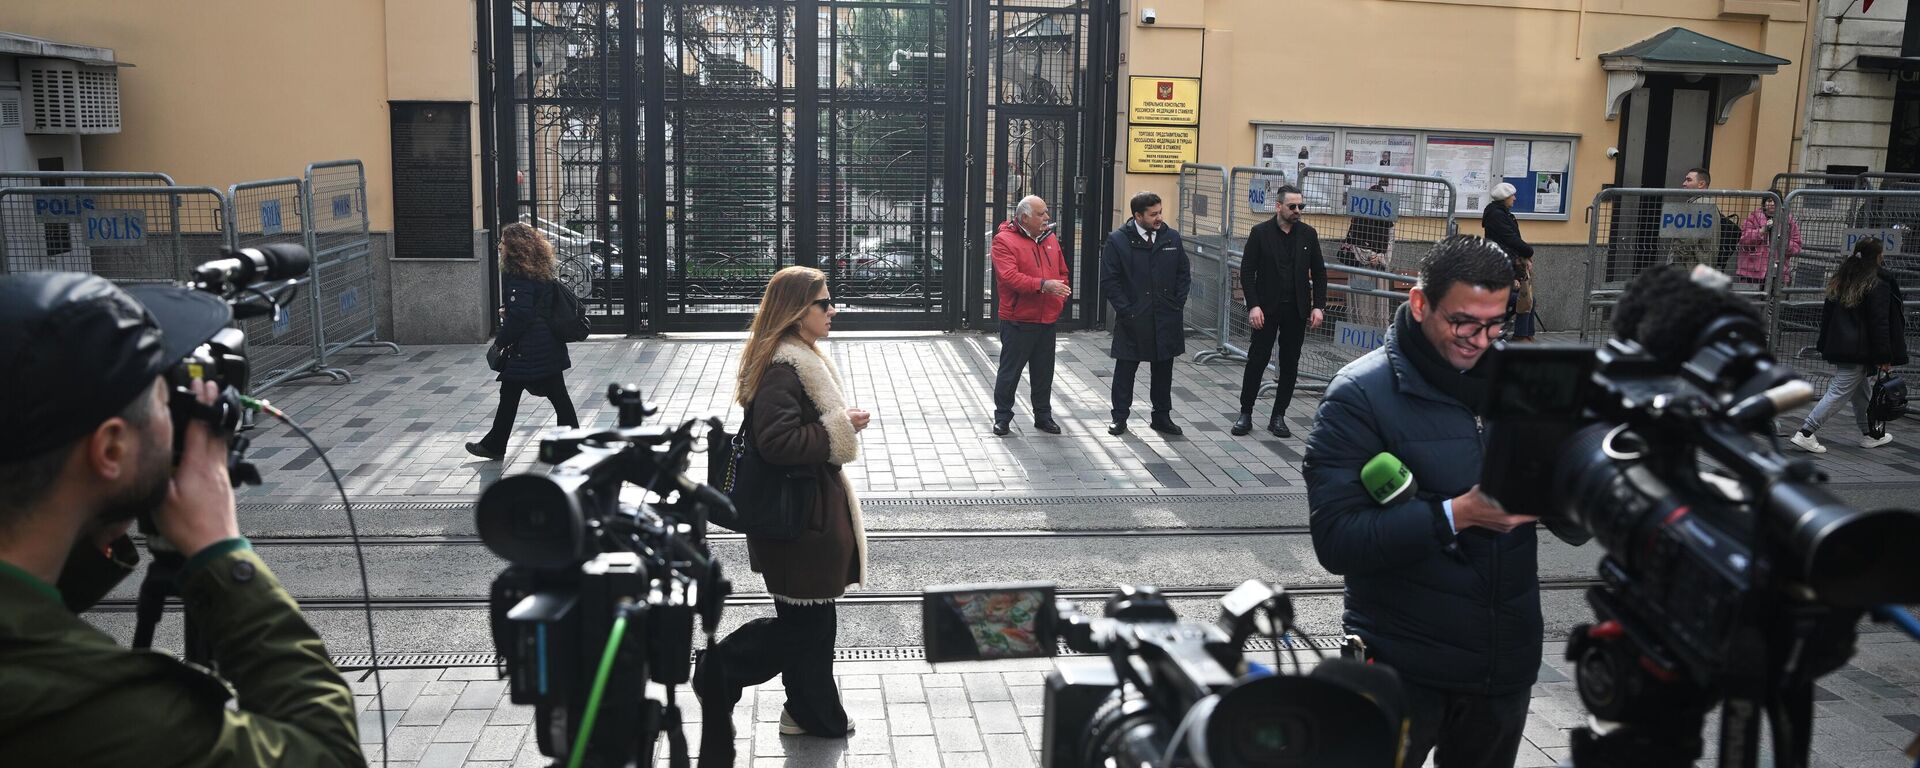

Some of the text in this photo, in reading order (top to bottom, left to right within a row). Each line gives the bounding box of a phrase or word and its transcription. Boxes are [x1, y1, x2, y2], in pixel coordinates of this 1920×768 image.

[36, 195, 95, 215] POLİS
[1350, 195, 1392, 218] POLİS
[86, 212, 142, 240] POLİS
[1662, 210, 1713, 229] POLİS
[1847, 231, 1894, 251] PİS
[1341, 327, 1383, 349] POLİS
